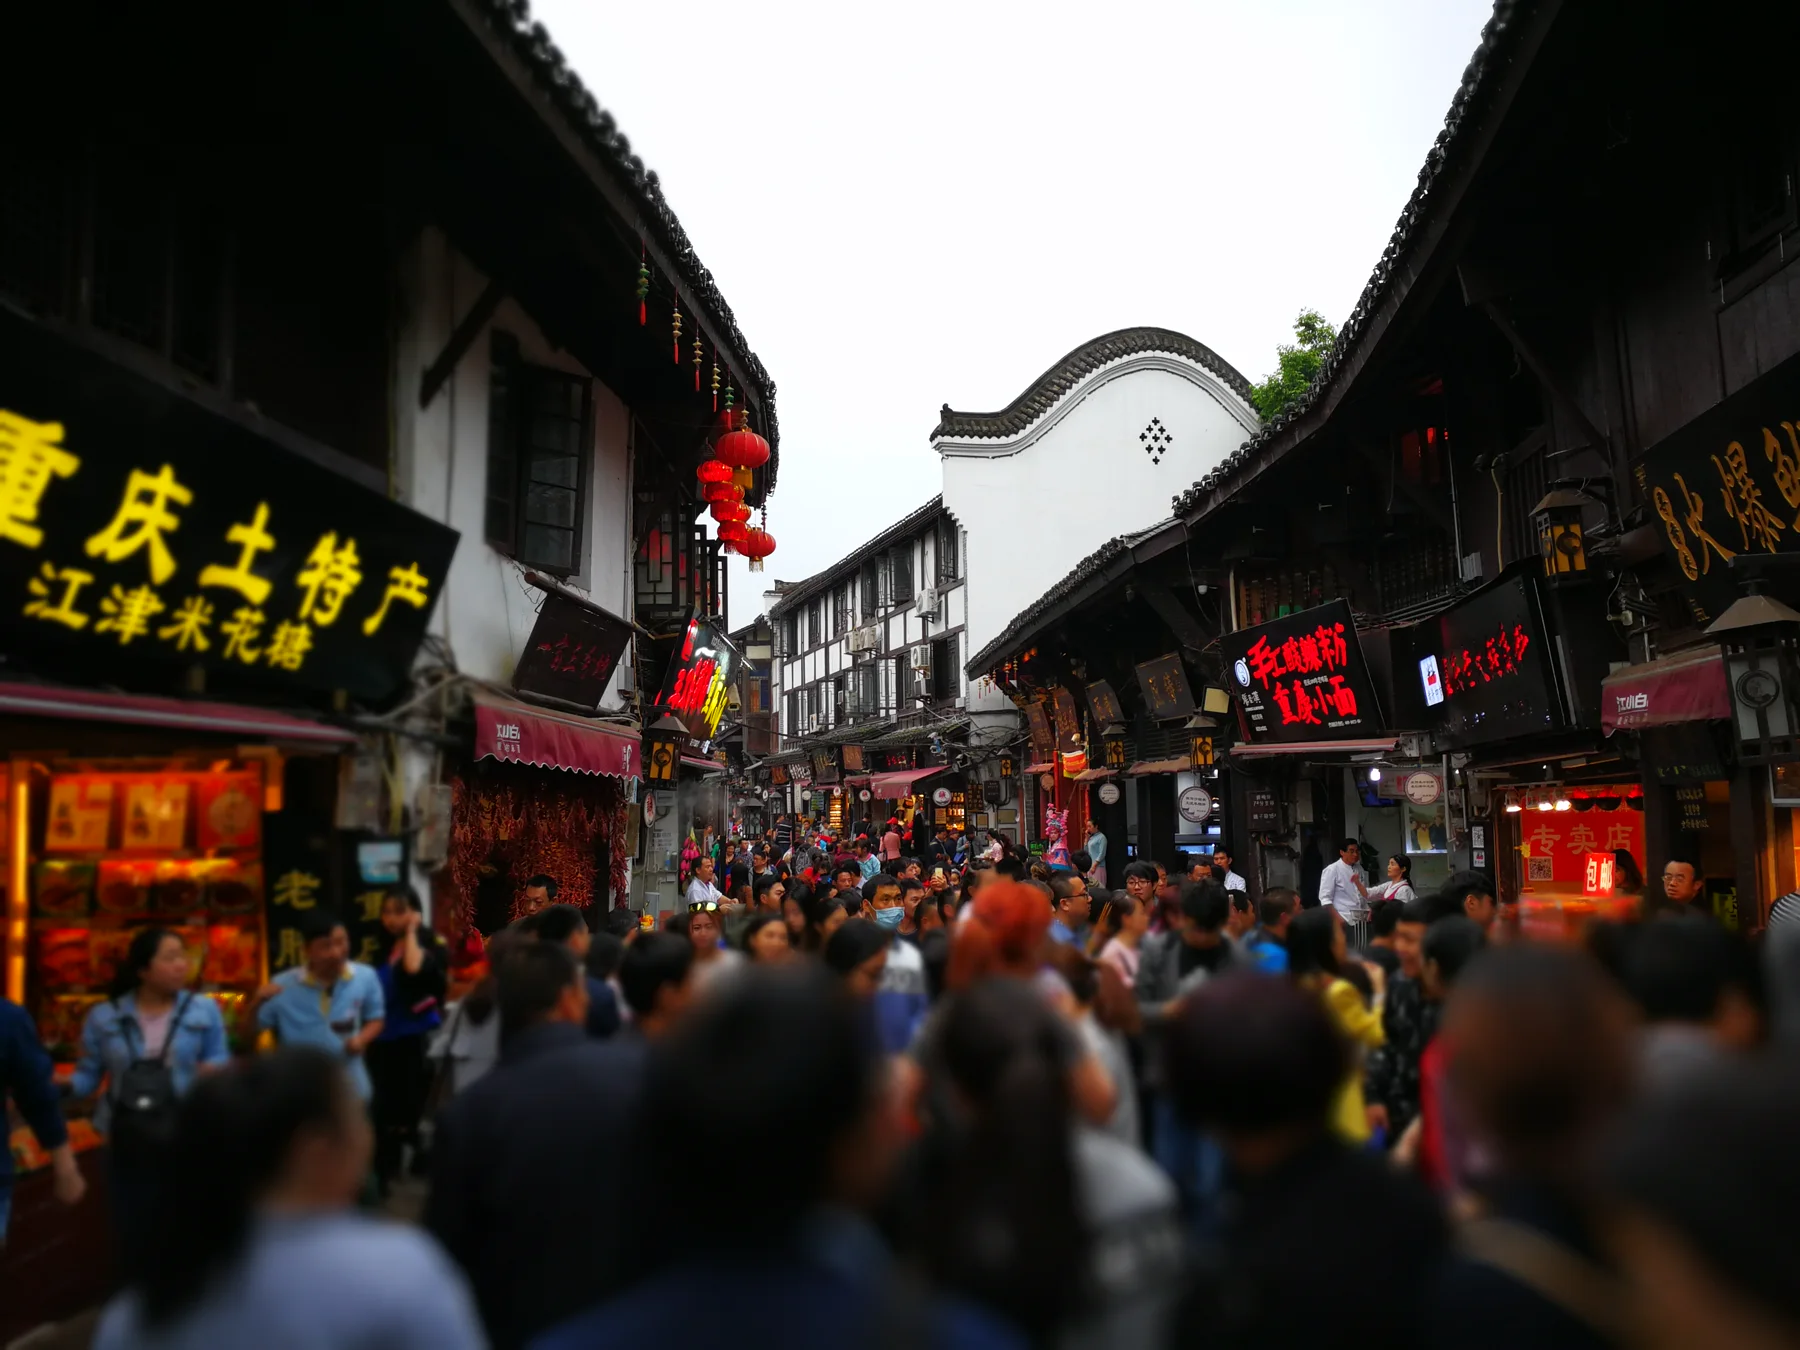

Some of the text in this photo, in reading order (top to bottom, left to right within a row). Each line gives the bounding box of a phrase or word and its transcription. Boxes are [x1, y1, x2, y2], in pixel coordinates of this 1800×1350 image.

[0, 409, 429, 636] 重庆土特产
[23, 562, 313, 671] 江津米花糖
[1616, 692, 1649, 713] 江小白
[1530, 821, 1634, 857] 专卖店
[1585, 856, 1613, 893] 包邮
